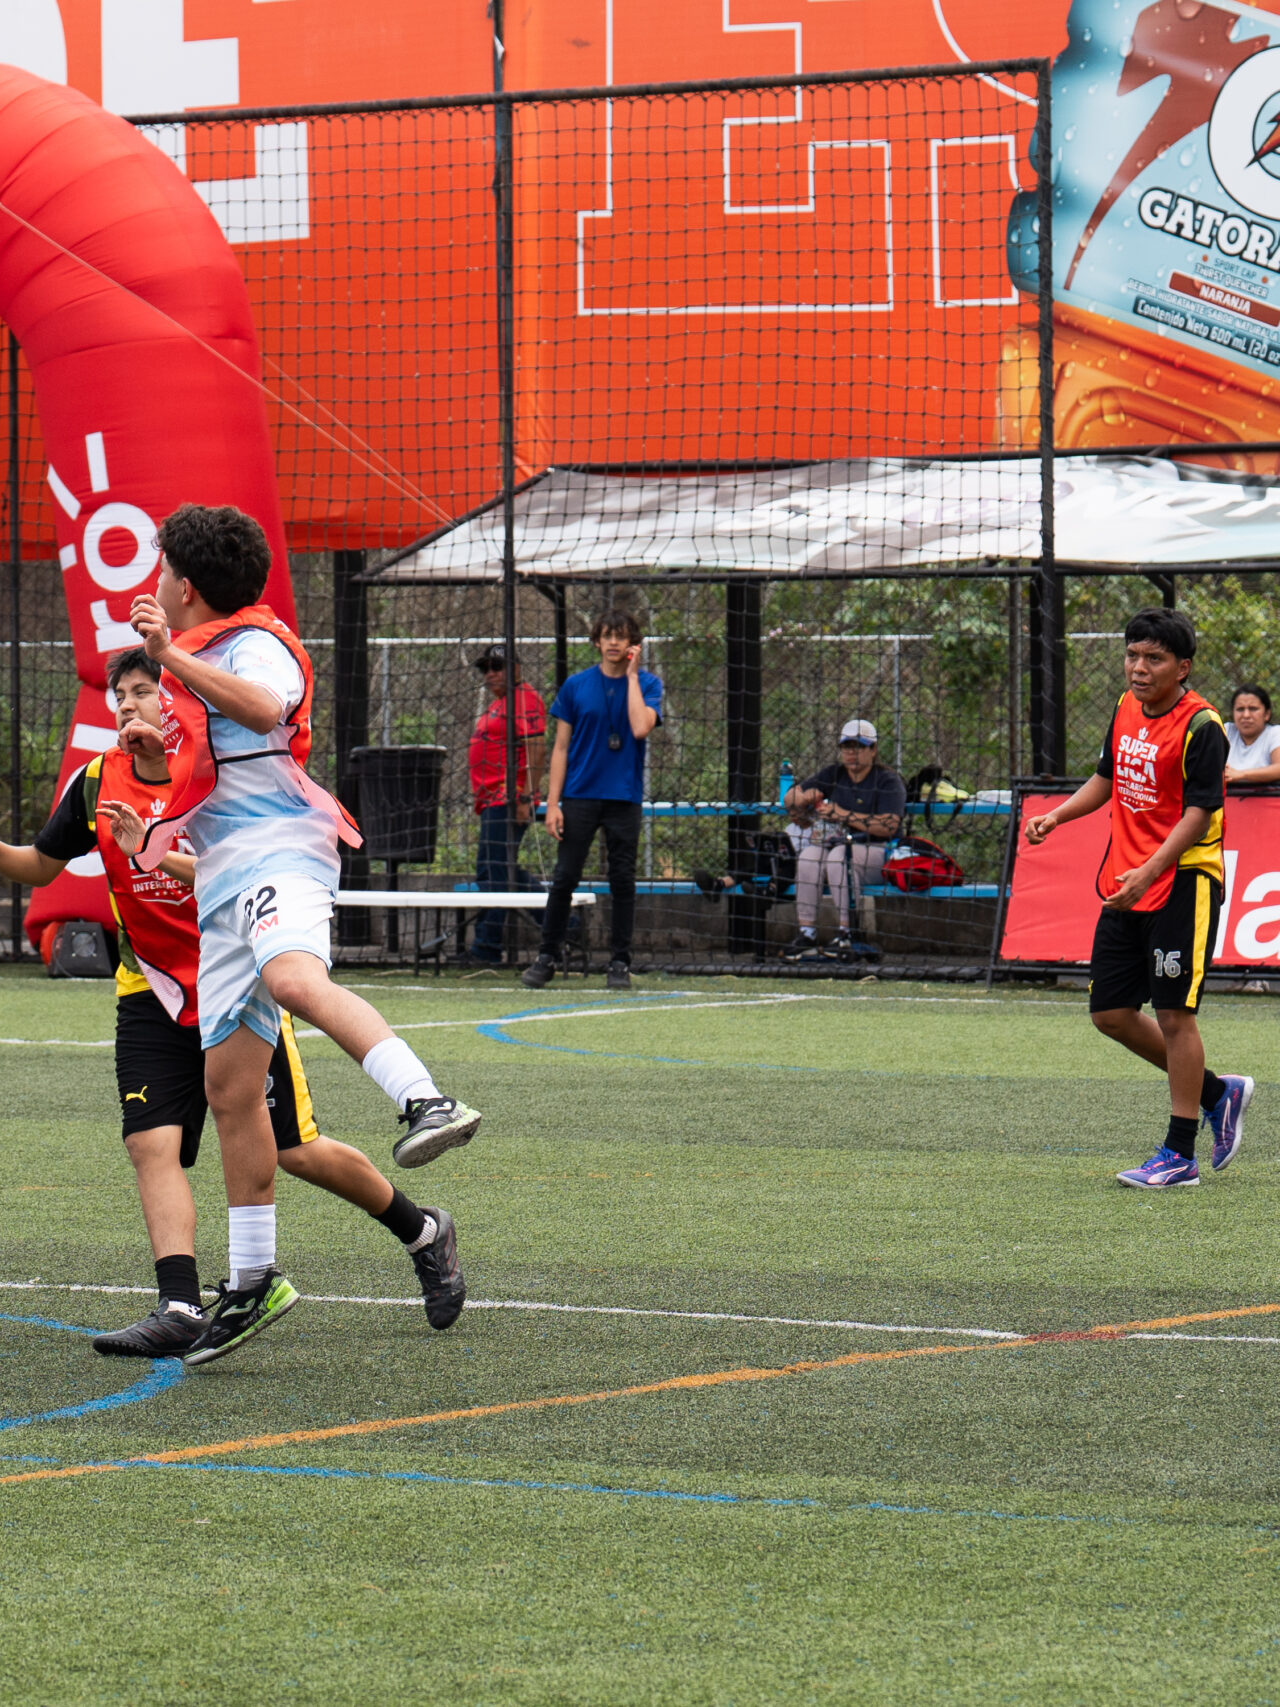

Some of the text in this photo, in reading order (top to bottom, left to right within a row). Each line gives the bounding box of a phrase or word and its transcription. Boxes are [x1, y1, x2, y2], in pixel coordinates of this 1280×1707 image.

[1199, 284, 1251, 315] NARANJA
[1137, 298, 1186, 329] Contenido
[1185, 312, 1210, 338] Neto
[1210, 325, 1233, 346] 600
[1118, 735, 1159, 762] SUPER
[1116, 751, 1157, 786] LIGA
[1153, 948, 1181, 978] 16
